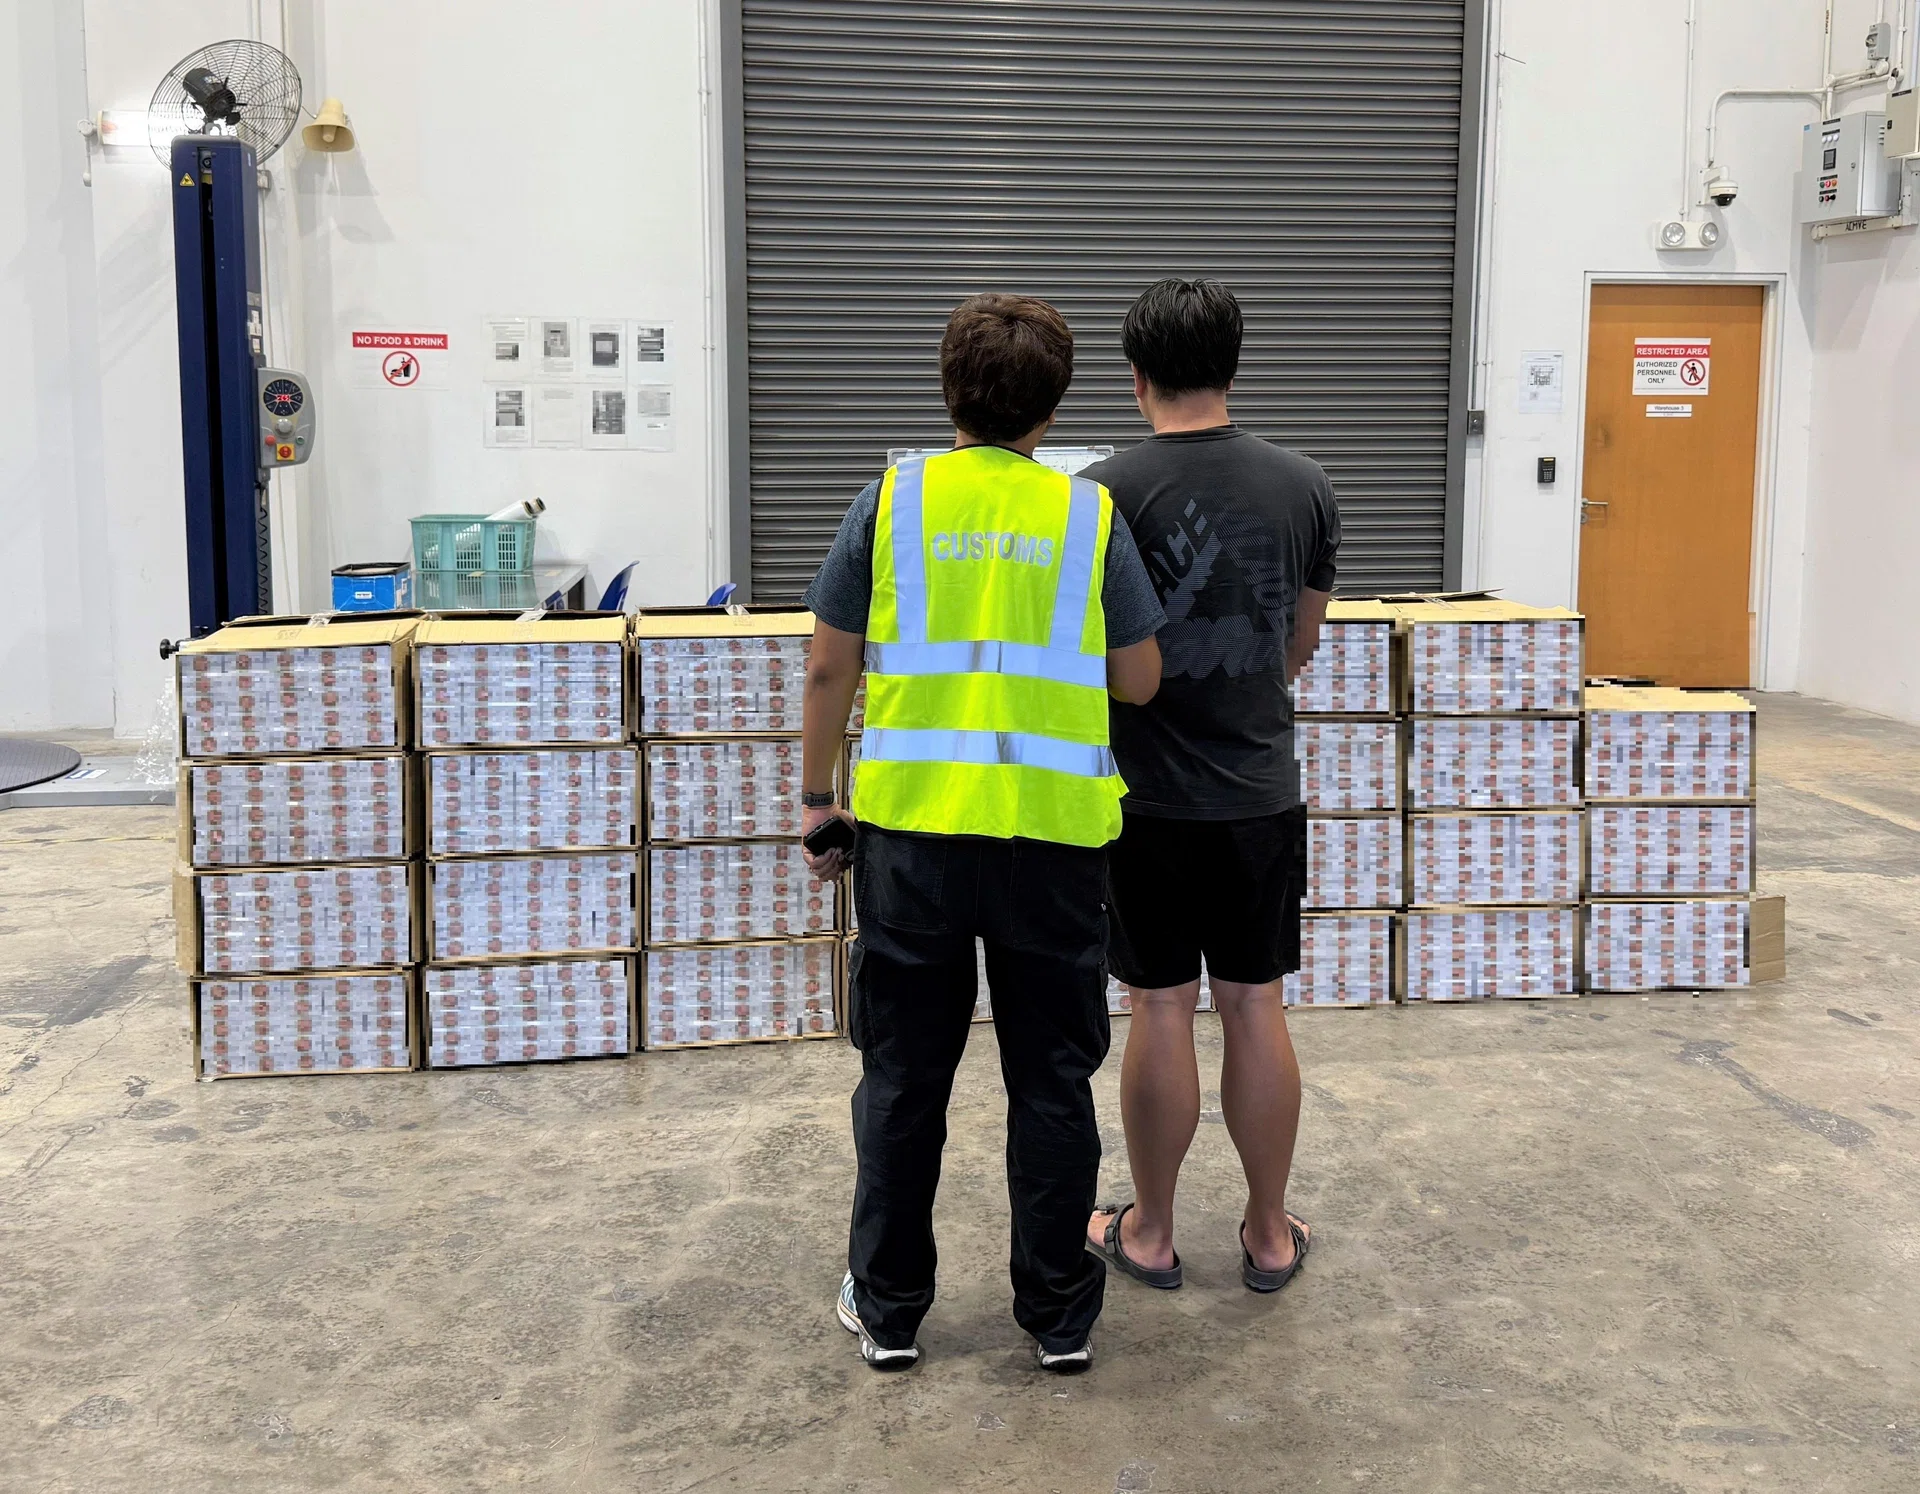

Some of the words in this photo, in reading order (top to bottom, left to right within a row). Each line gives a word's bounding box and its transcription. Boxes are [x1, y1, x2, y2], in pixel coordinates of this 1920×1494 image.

[357, 336, 371, 344] NO
[374, 336, 401, 345] FOOD
[404, 337, 411, 345] &
[413, 337, 444, 346] DRINK
[932, 532, 1055, 567] CUSTOMS
